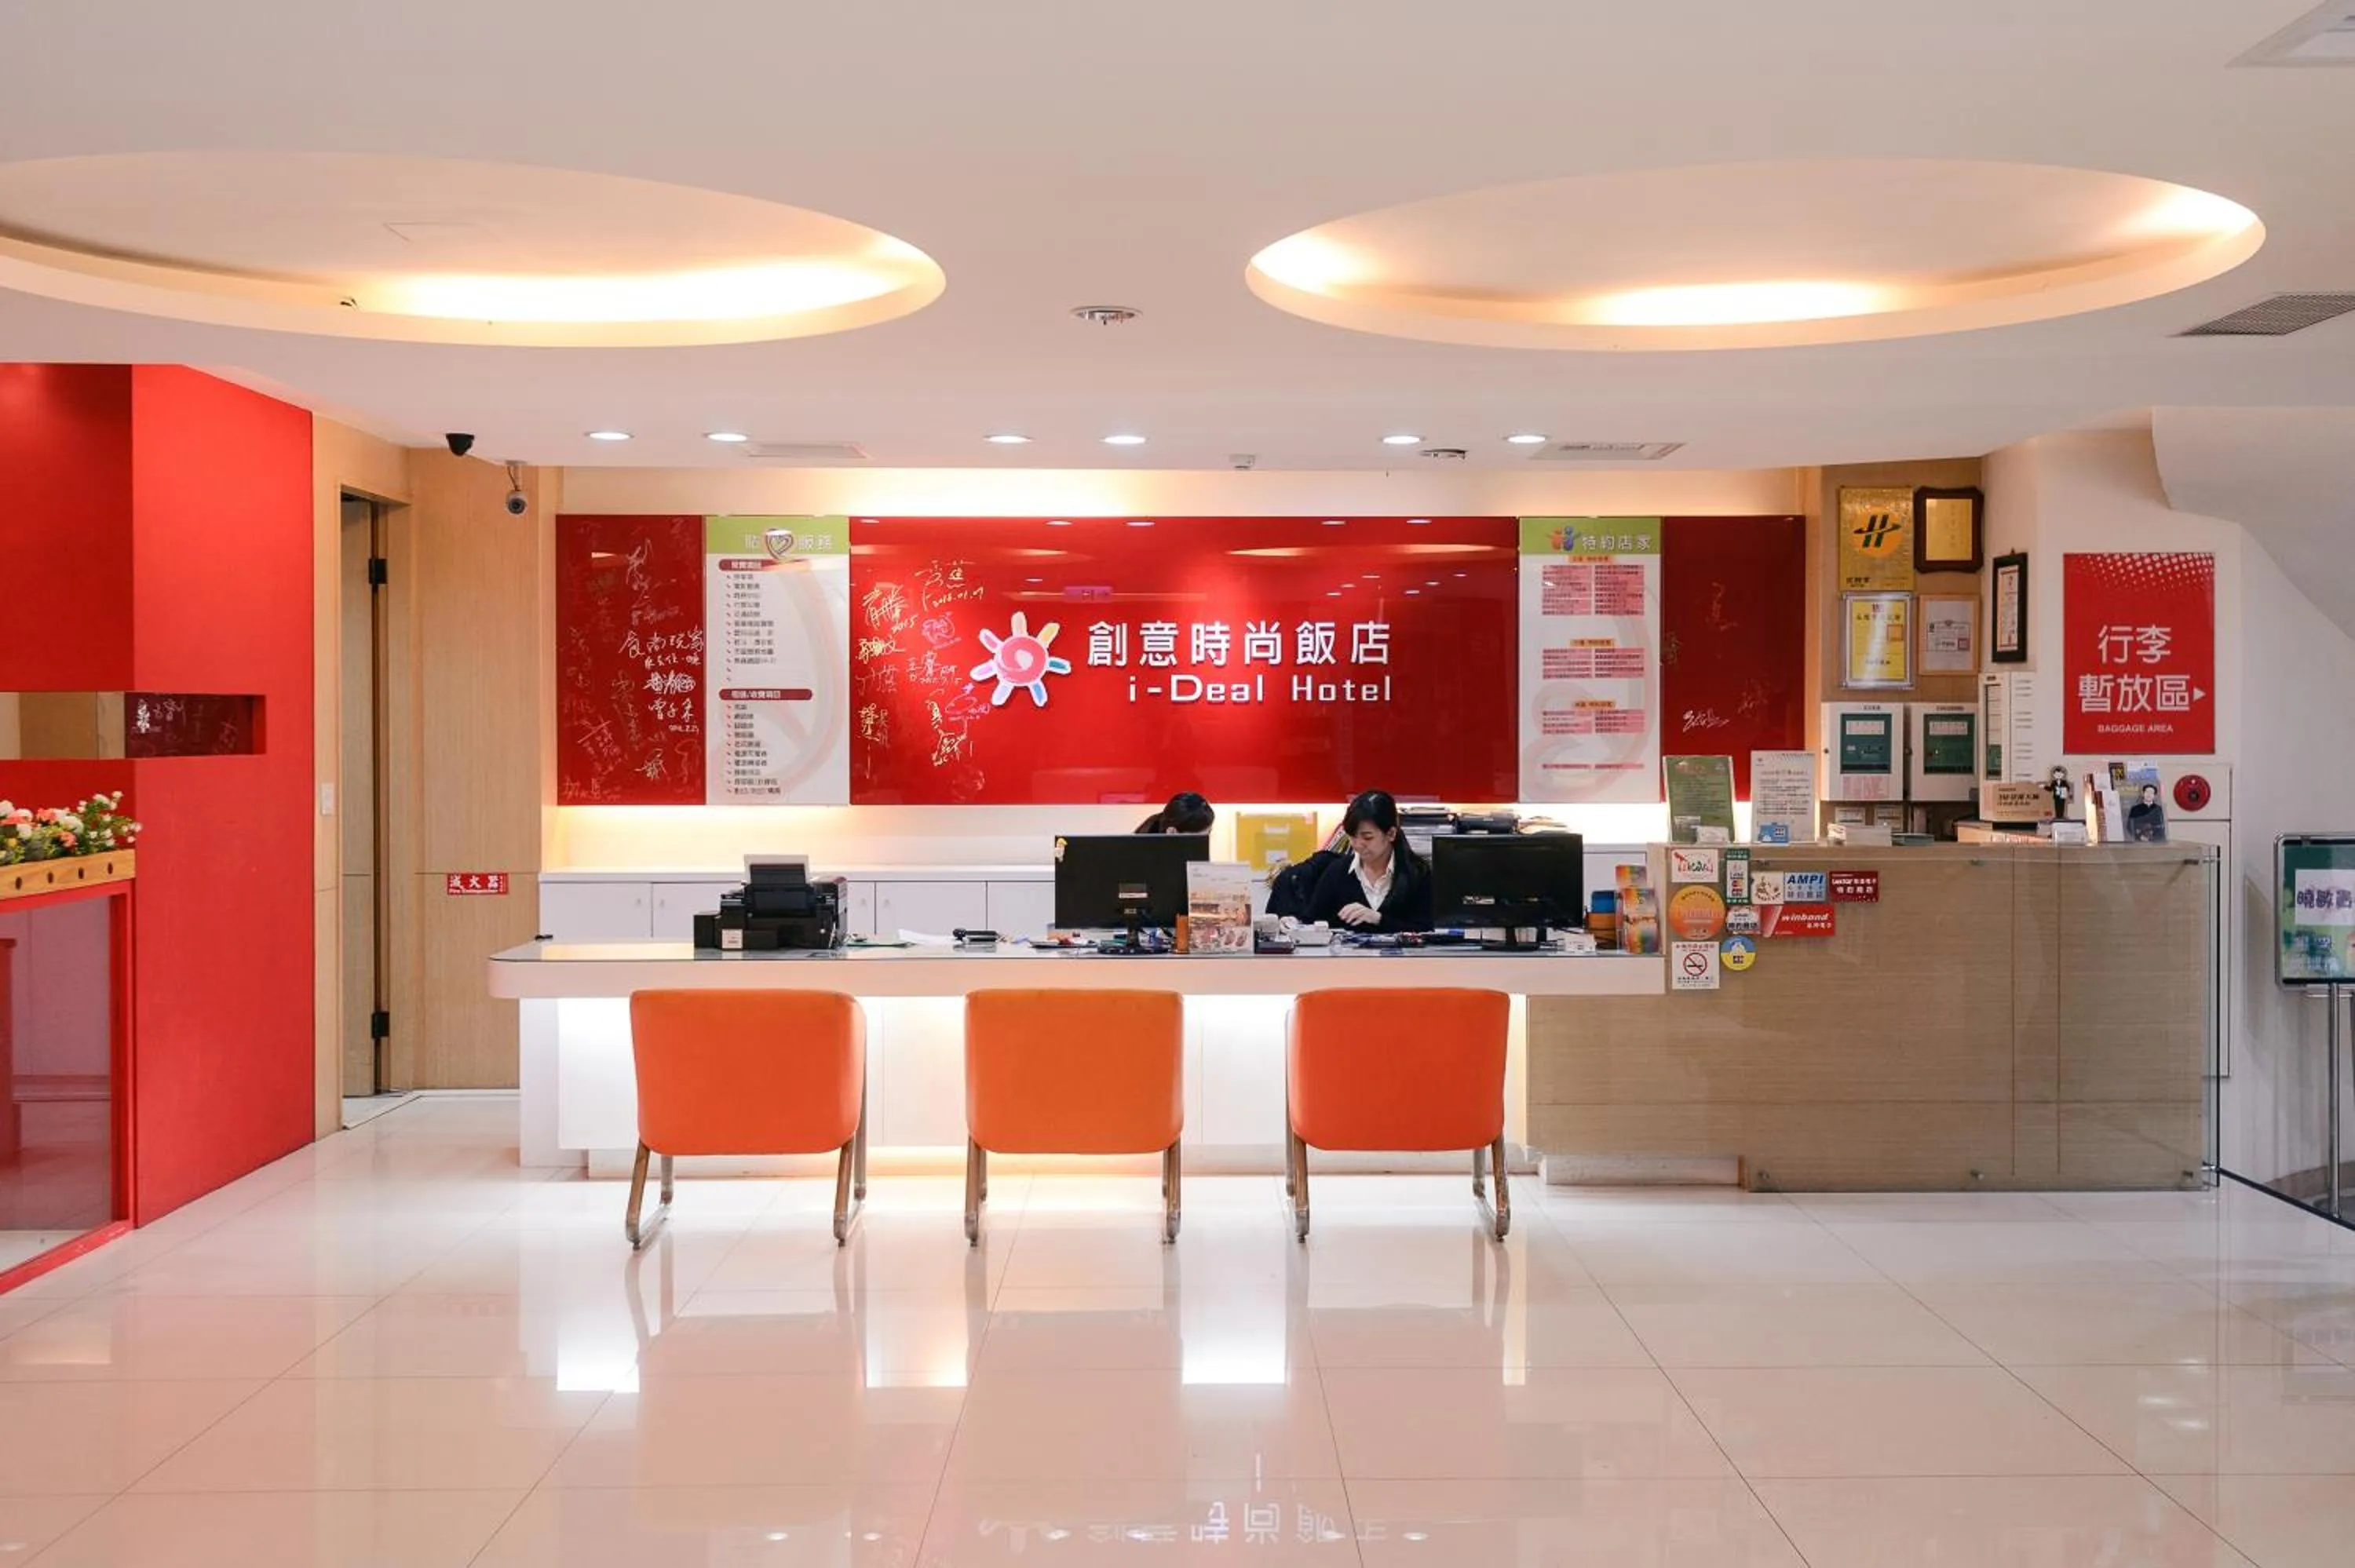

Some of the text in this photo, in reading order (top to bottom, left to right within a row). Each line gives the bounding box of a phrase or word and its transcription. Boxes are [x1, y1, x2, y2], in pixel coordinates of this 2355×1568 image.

[1087, 621, 1390, 666] 創意時尚飯店
[2098, 624, 2172, 664] 行李
[1129, 674, 1391, 702] i-Deal Hotel
[2078, 673, 2191, 713] 暫放區
[2097, 724, 2173, 734] BAGGAGE AREA
[1787, 874, 1824, 884] AMPI
[1780, 913, 1830, 921] winbond
